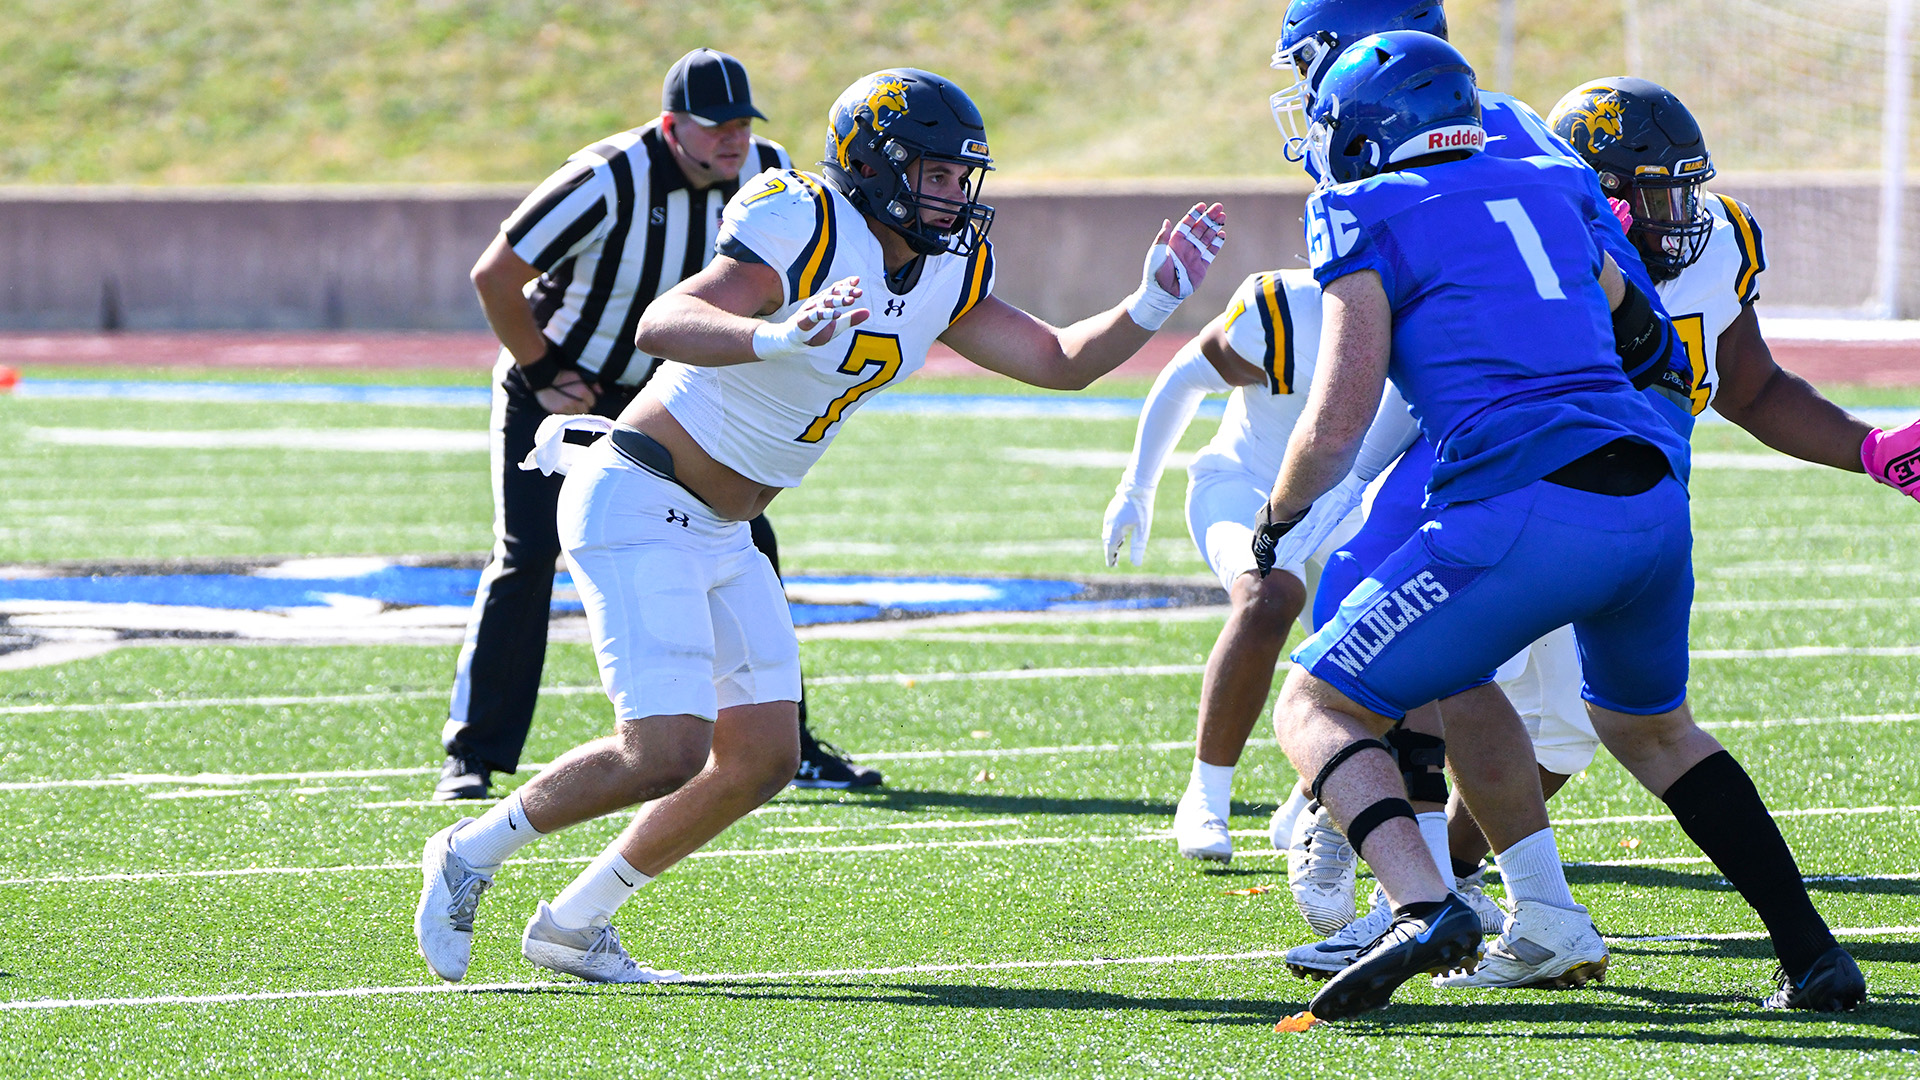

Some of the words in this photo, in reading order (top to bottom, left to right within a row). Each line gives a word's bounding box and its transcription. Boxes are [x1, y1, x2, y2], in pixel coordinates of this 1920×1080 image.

[1427, 129, 1485, 150] Riddell
[650, 206, 666, 226] S
[740, 177, 788, 208] 7
[1483, 198, 1568, 300] 1
[793, 329, 903, 443] 7
[1326, 570, 1450, 678] WILDCATS
